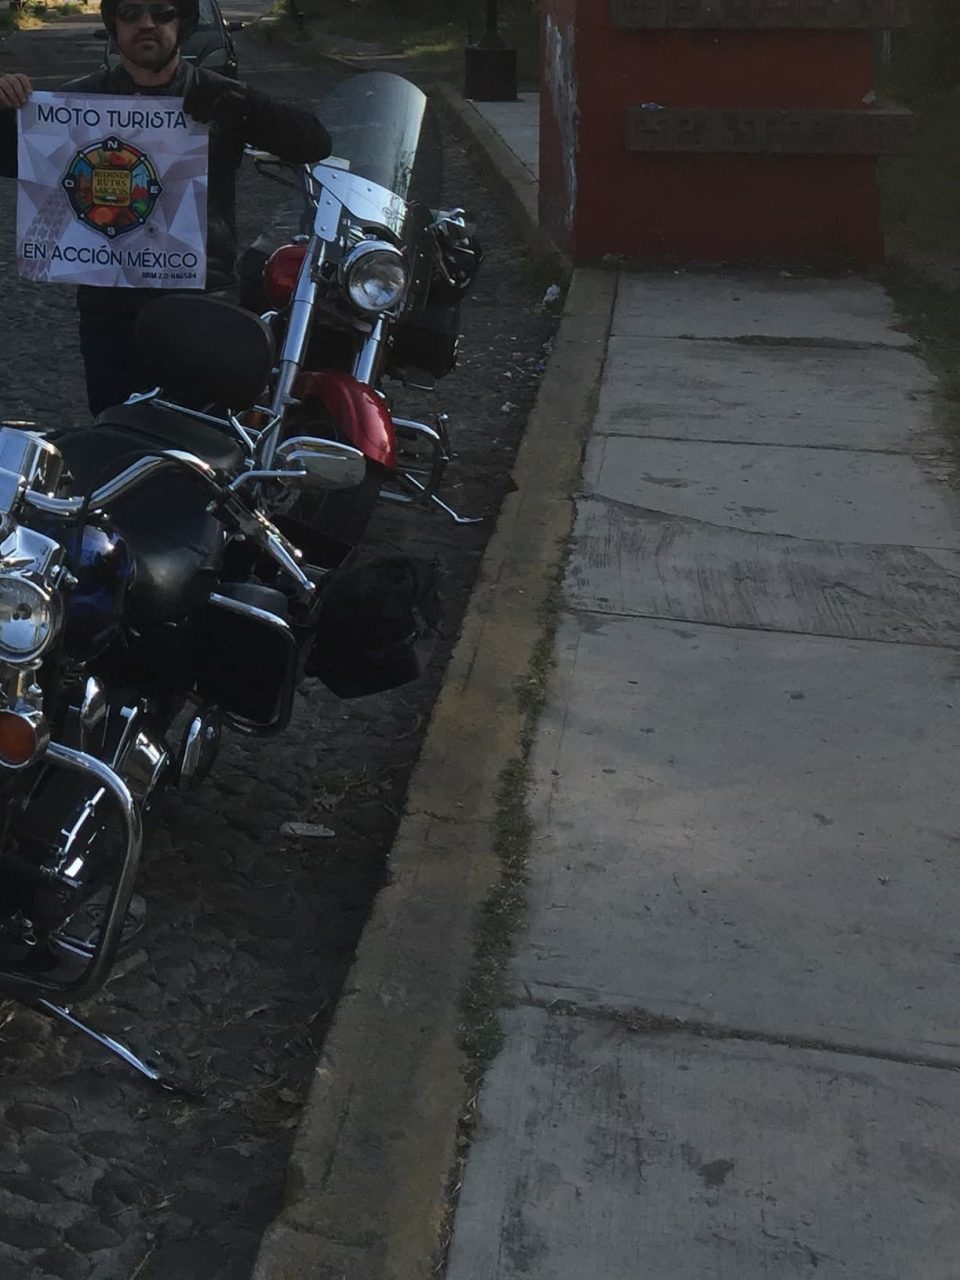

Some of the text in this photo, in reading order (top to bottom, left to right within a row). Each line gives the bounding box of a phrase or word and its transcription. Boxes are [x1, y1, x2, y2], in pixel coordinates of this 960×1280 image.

[37, 105, 187, 129] MOTO TURISTA
[107, 227, 115, 235] S
[23, 242, 198, 269] EN ACCIÓN MÉXICO
